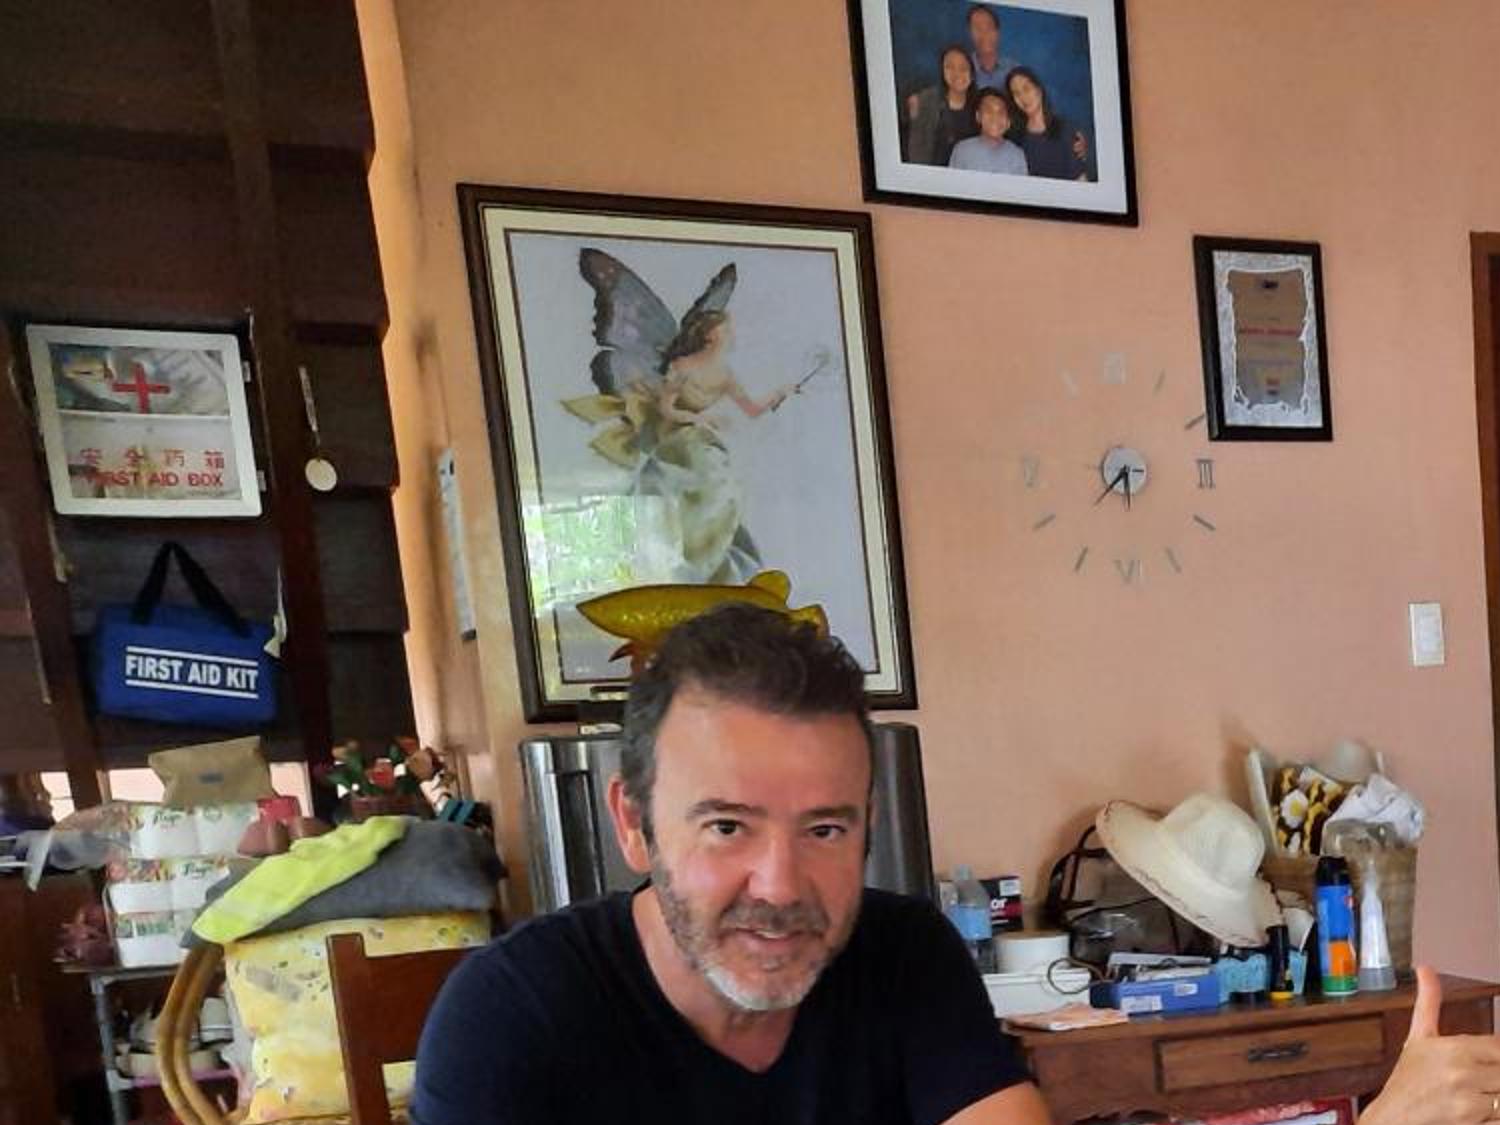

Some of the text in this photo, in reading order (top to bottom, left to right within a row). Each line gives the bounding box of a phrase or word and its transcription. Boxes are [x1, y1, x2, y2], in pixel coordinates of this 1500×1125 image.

[125, 654, 259, 691] FIRST AID KIT
